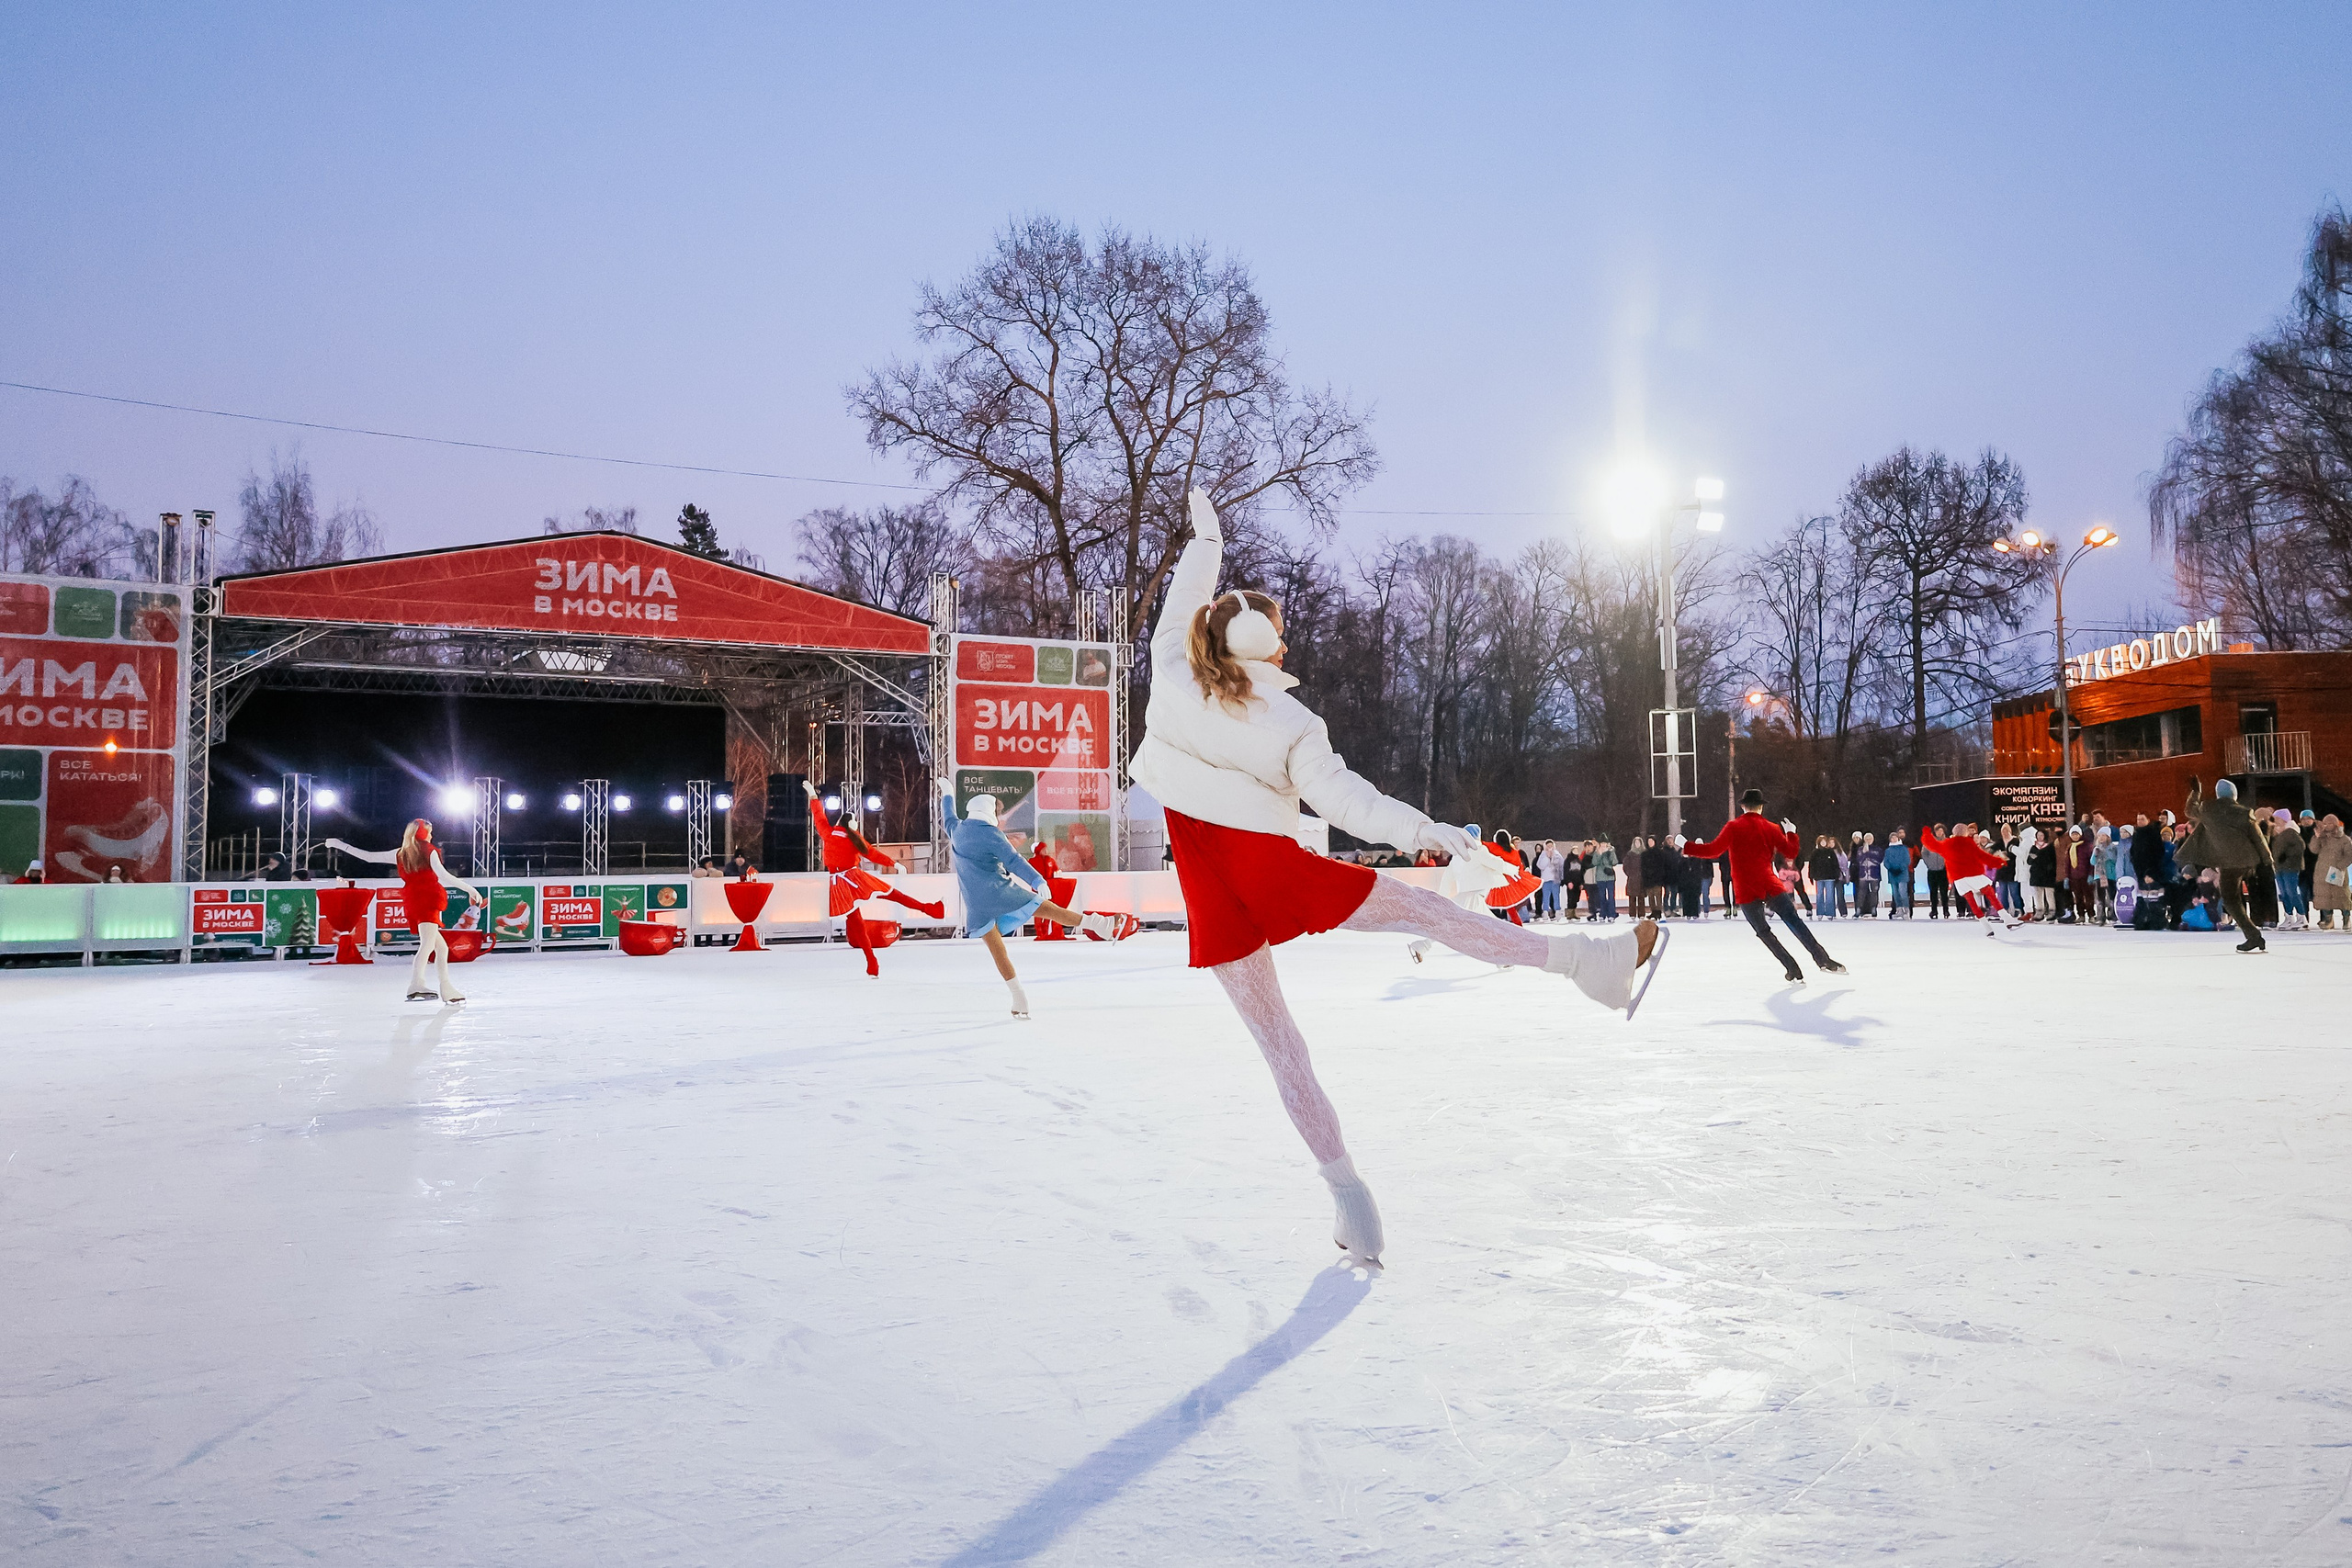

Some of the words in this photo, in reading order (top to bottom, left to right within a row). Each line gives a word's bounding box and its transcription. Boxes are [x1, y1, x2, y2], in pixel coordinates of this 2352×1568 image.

[535, 558, 677, 598] ЗИМА
[535, 595, 552, 614] В
[562, 597, 678, 622] МОСКВЕ
[974, 698, 1093, 732] ЗИМА
[974, 735, 989, 751] В
[998, 736, 1094, 754] МОСКВЕ
[60, 760, 92, 769] ВСЕ
[60, 772, 141, 782] КАТАТЬСЯ!
[965, 785, 1023, 794] ТАНЦЕВАТЬ!
[1047, 786, 1066, 795] ВСЕ
[1992, 786, 2058, 795] ЭКОМАГАЗИН
[2030, 803, 2066, 816] КАФ
[1995, 814, 2030, 823] КНИГИ
[384, 907, 405, 917] ЗИ
[550, 903, 594, 914] ЗИМА
[203, 908, 254, 920] ЗИМА
